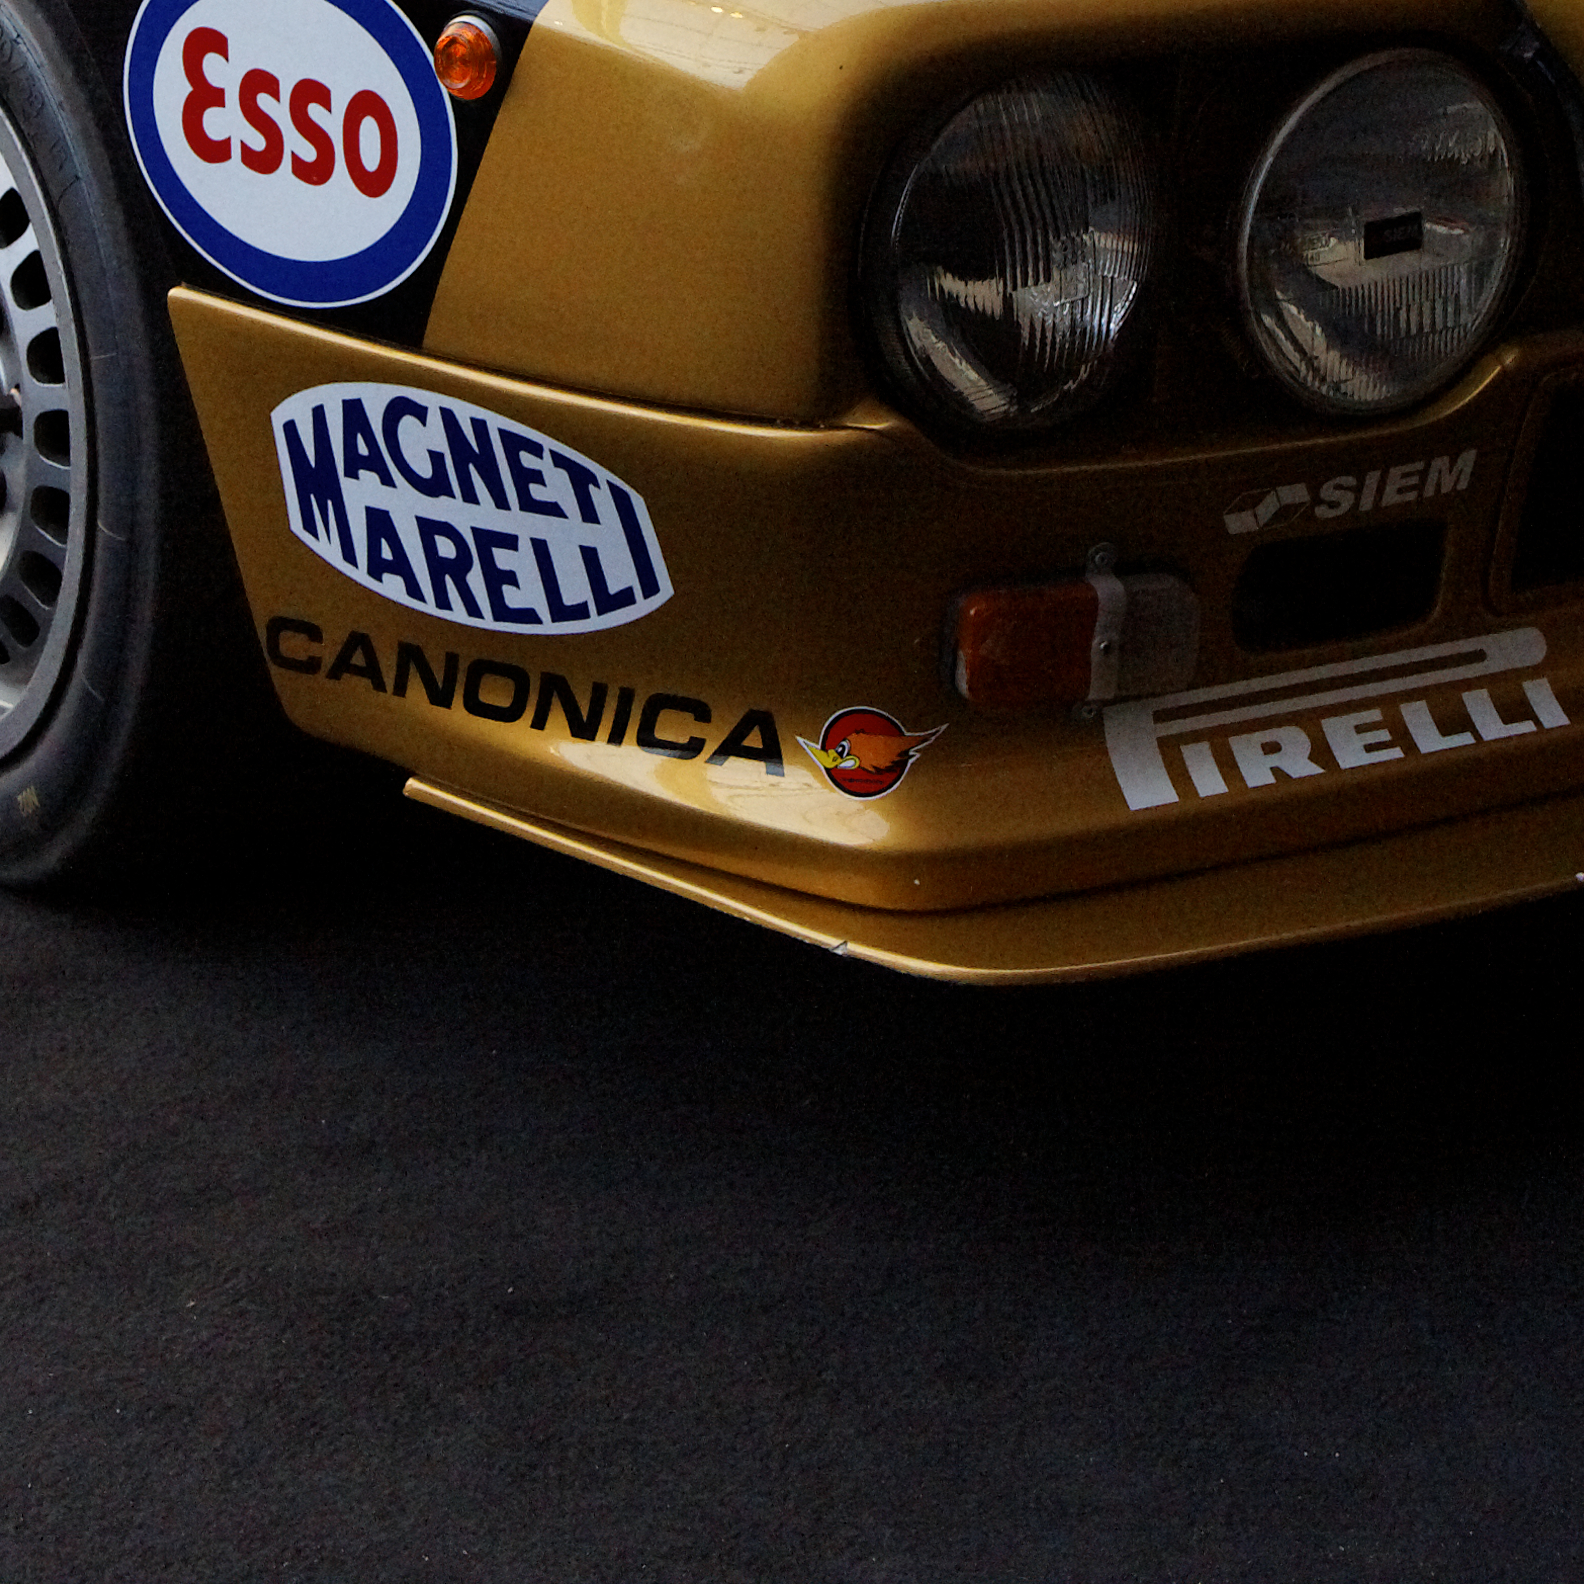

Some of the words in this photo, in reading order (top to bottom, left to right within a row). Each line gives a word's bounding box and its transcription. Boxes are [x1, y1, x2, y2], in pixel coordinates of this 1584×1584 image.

[182, 26, 399, 199] Esso
[283, 395, 660, 576] MAGNETI
[301, 478, 660, 625] MARELLI
[1313, 449, 1479, 519] SIEM
[266, 615, 787, 776] CANONICA
[1103, 626, 1572, 811] PIRELLI
